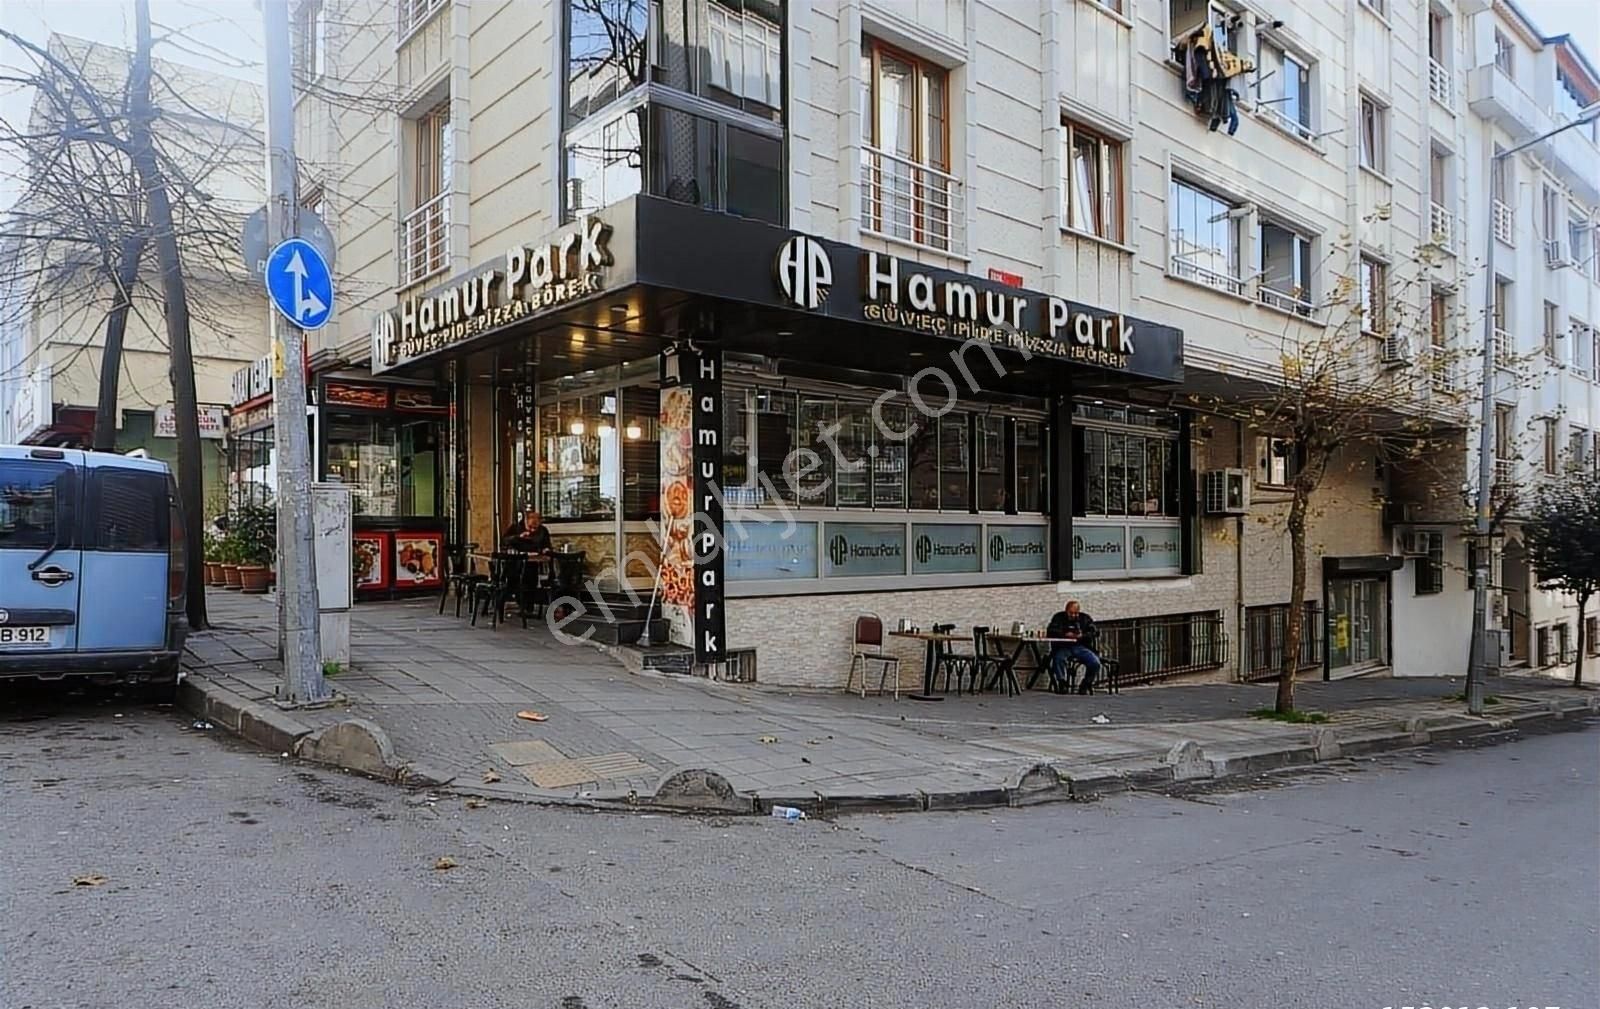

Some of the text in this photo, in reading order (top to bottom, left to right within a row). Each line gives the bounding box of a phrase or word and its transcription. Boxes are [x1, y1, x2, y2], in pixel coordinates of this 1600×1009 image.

[401, 270, 495, 341] Hamur
[505, 212, 603, 300] Park
[478, 300, 524, 331] PİZZA
[868, 251, 1027, 331] Hamur
[1048, 296, 1136, 355] Park
[698, 358, 718, 653] Hamur Park
[850, 543, 901, 559] HamurPark
[933, 542, 976, 557] HamurPark
[19, 628, 45, 642] 912
